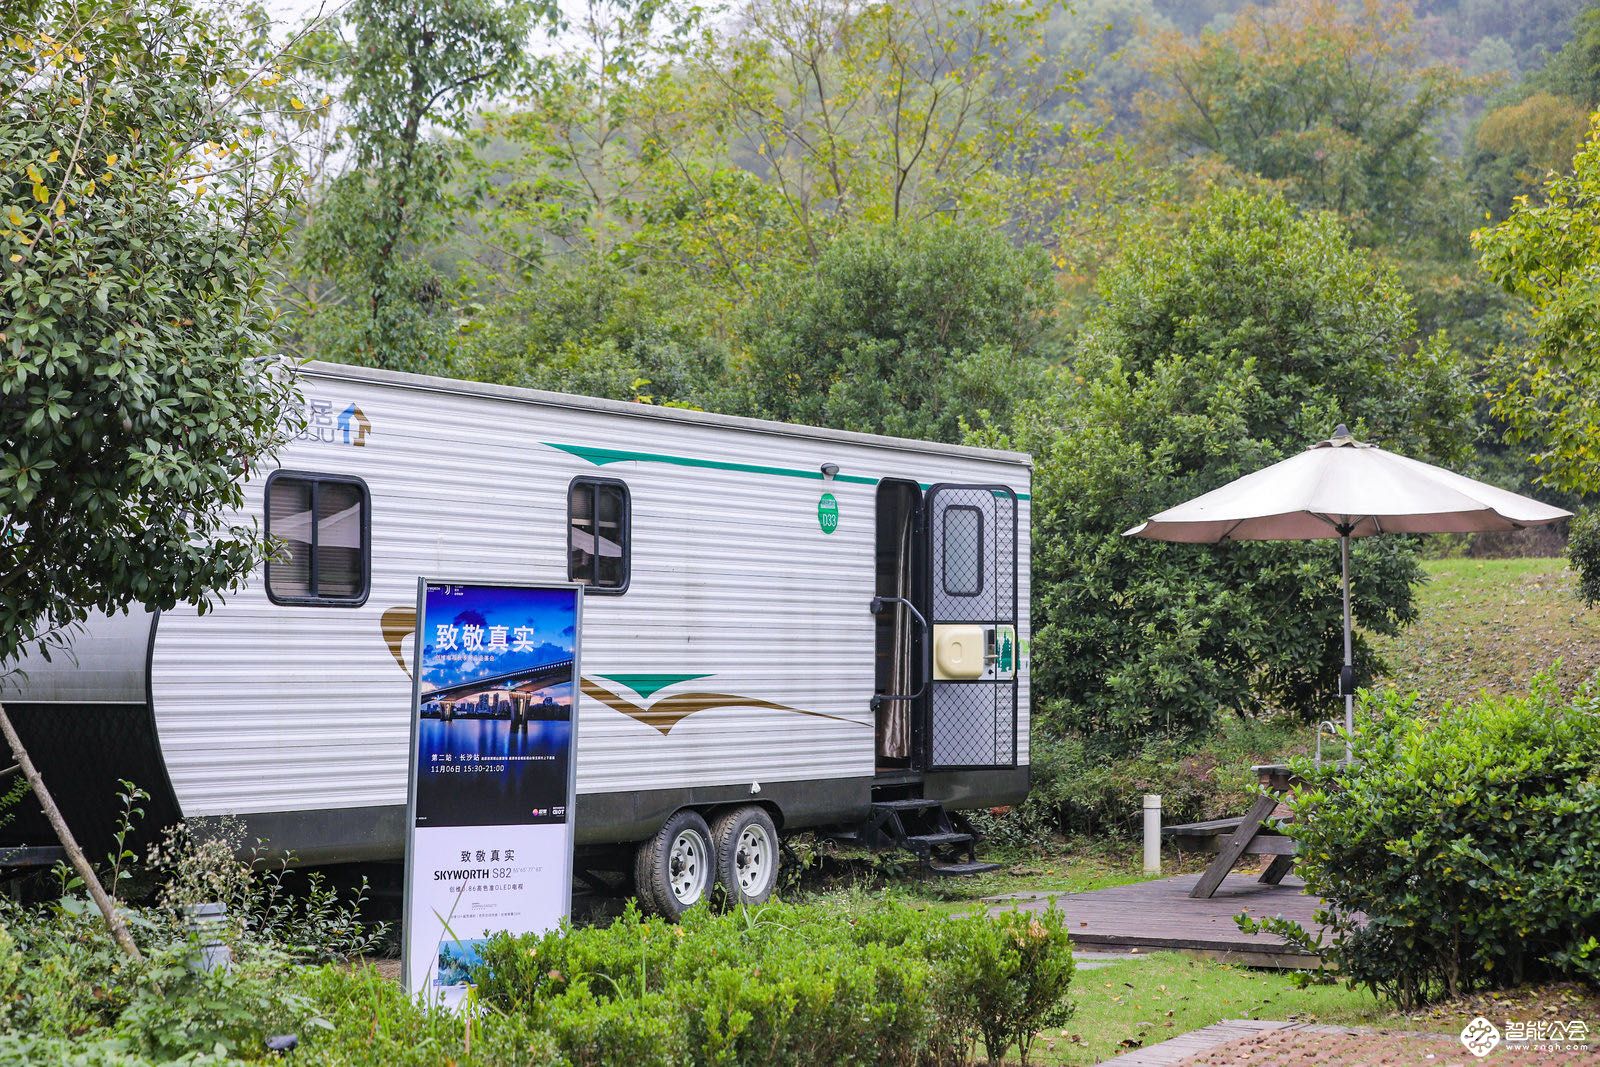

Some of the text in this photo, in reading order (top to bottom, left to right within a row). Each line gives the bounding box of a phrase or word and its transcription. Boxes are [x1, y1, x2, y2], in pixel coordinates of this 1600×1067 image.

[822, 513, 837, 527] D33
[435, 623, 535, 653] 致敬真实
[431, 764, 505, 773] 11月06日 15:30-21:00
[461, 849, 515, 863] 致敬真实
[433, 868, 490, 881] SKYWORTH
[492, 867, 512, 879] S82
